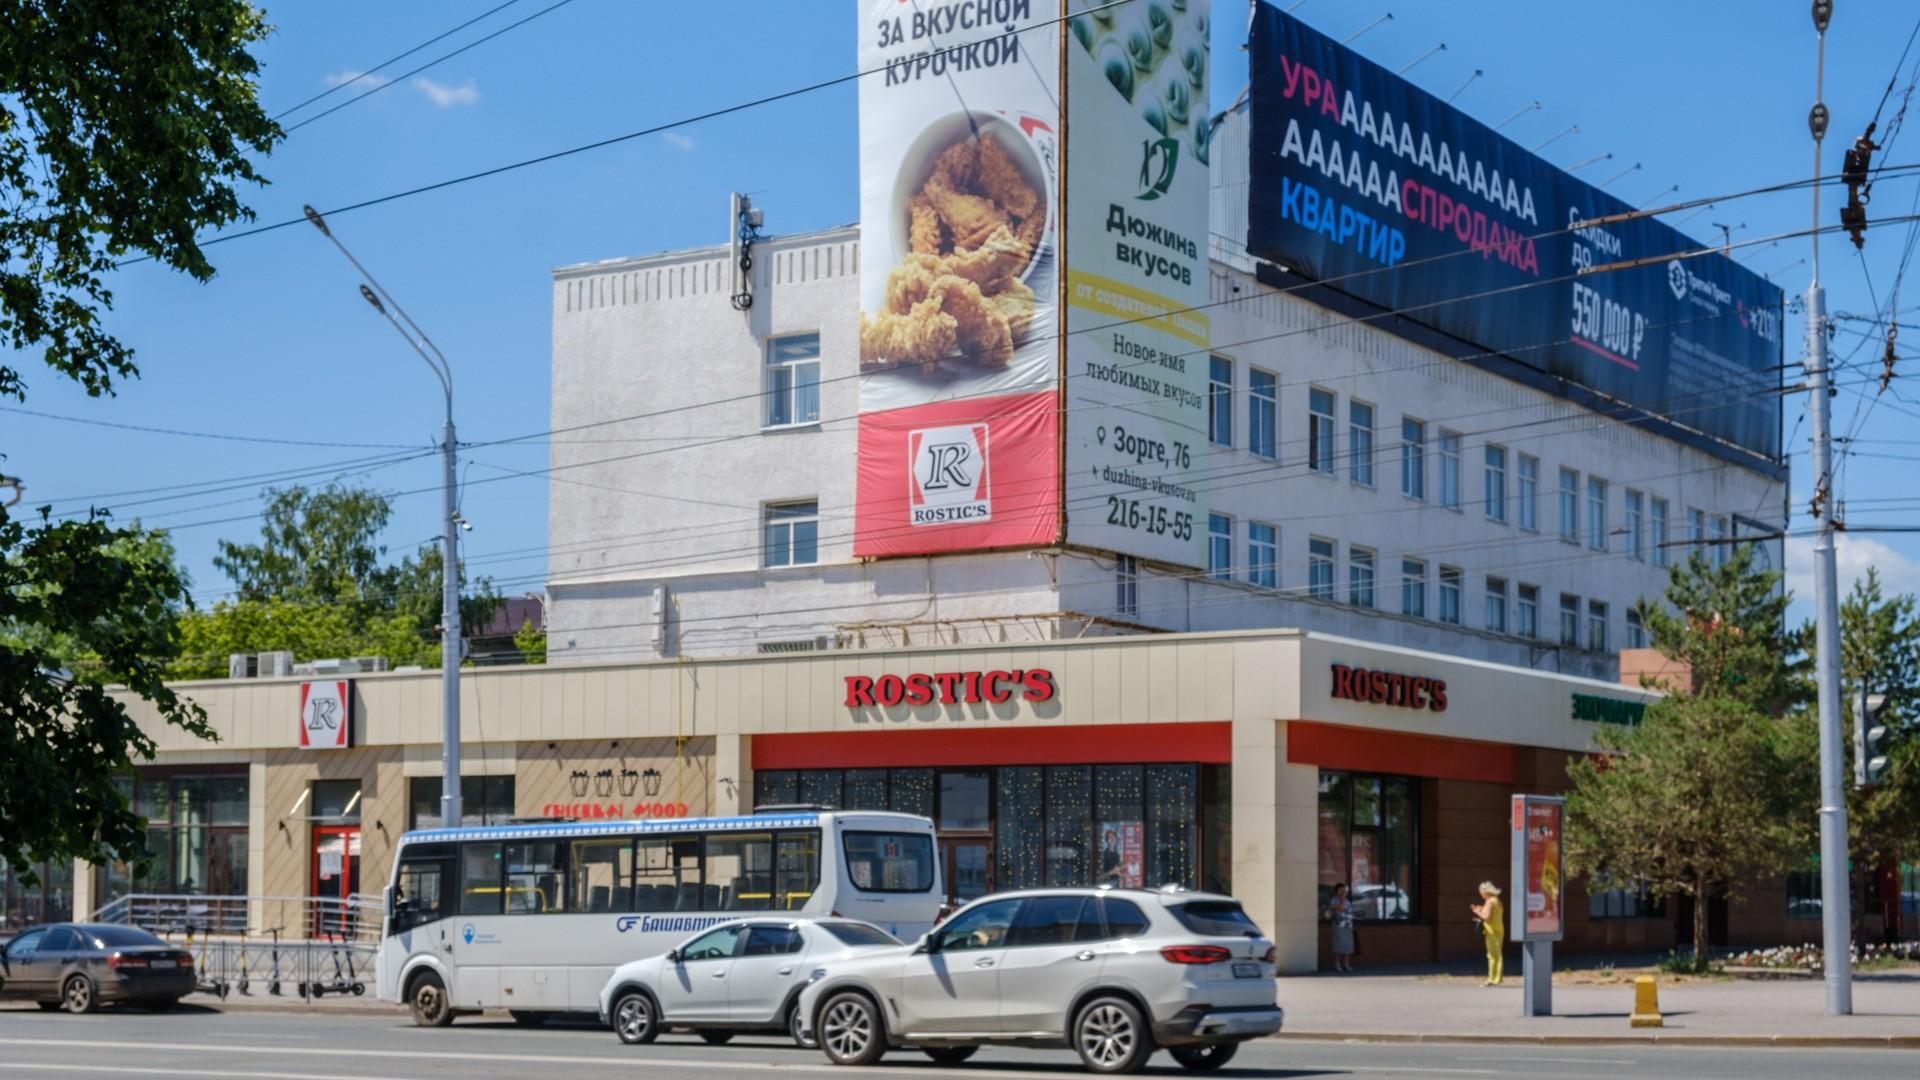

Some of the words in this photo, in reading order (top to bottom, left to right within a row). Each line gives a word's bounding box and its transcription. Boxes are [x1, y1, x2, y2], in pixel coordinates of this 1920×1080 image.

[878, 17, 904, 48] ЗА
[912, 0, 1030, 40] ВКУСНОЙ
[885, 24, 1019, 87] КУРОЧКОЙ
[1280, 54, 1538, 226] УРАААААААААААА
[1280, 118, 1539, 277] ААААААСПРОДАЖА
[1106, 204, 1198, 260] Дюжина
[1281, 175, 1406, 267] КВАРТИР
[1569, 206, 1622, 258] Скидки
[1116, 242, 1193, 286] вкусов
[1572, 241, 1592, 269] до
[1571, 282, 1601, 340] 550
[1603, 297, 1631, 357] 000
[1113, 333, 1157, 363] Новое
[1159, 352, 1186, 374] имя
[1086, 362, 1161, 395] любимых
[1114, 426, 1168, 470] Зорге,
[1174, 441, 1190, 469] 76
[1103, 465, 1196, 502] duzhina-vkusov.ru
[913, 505, 988, 523] ROSTIC'S
[1107, 496, 1193, 541] 216-15-55
[844, 668, 1054, 707] ROSTIC'S
[1331, 664, 1447, 712] ROSTIC'S
